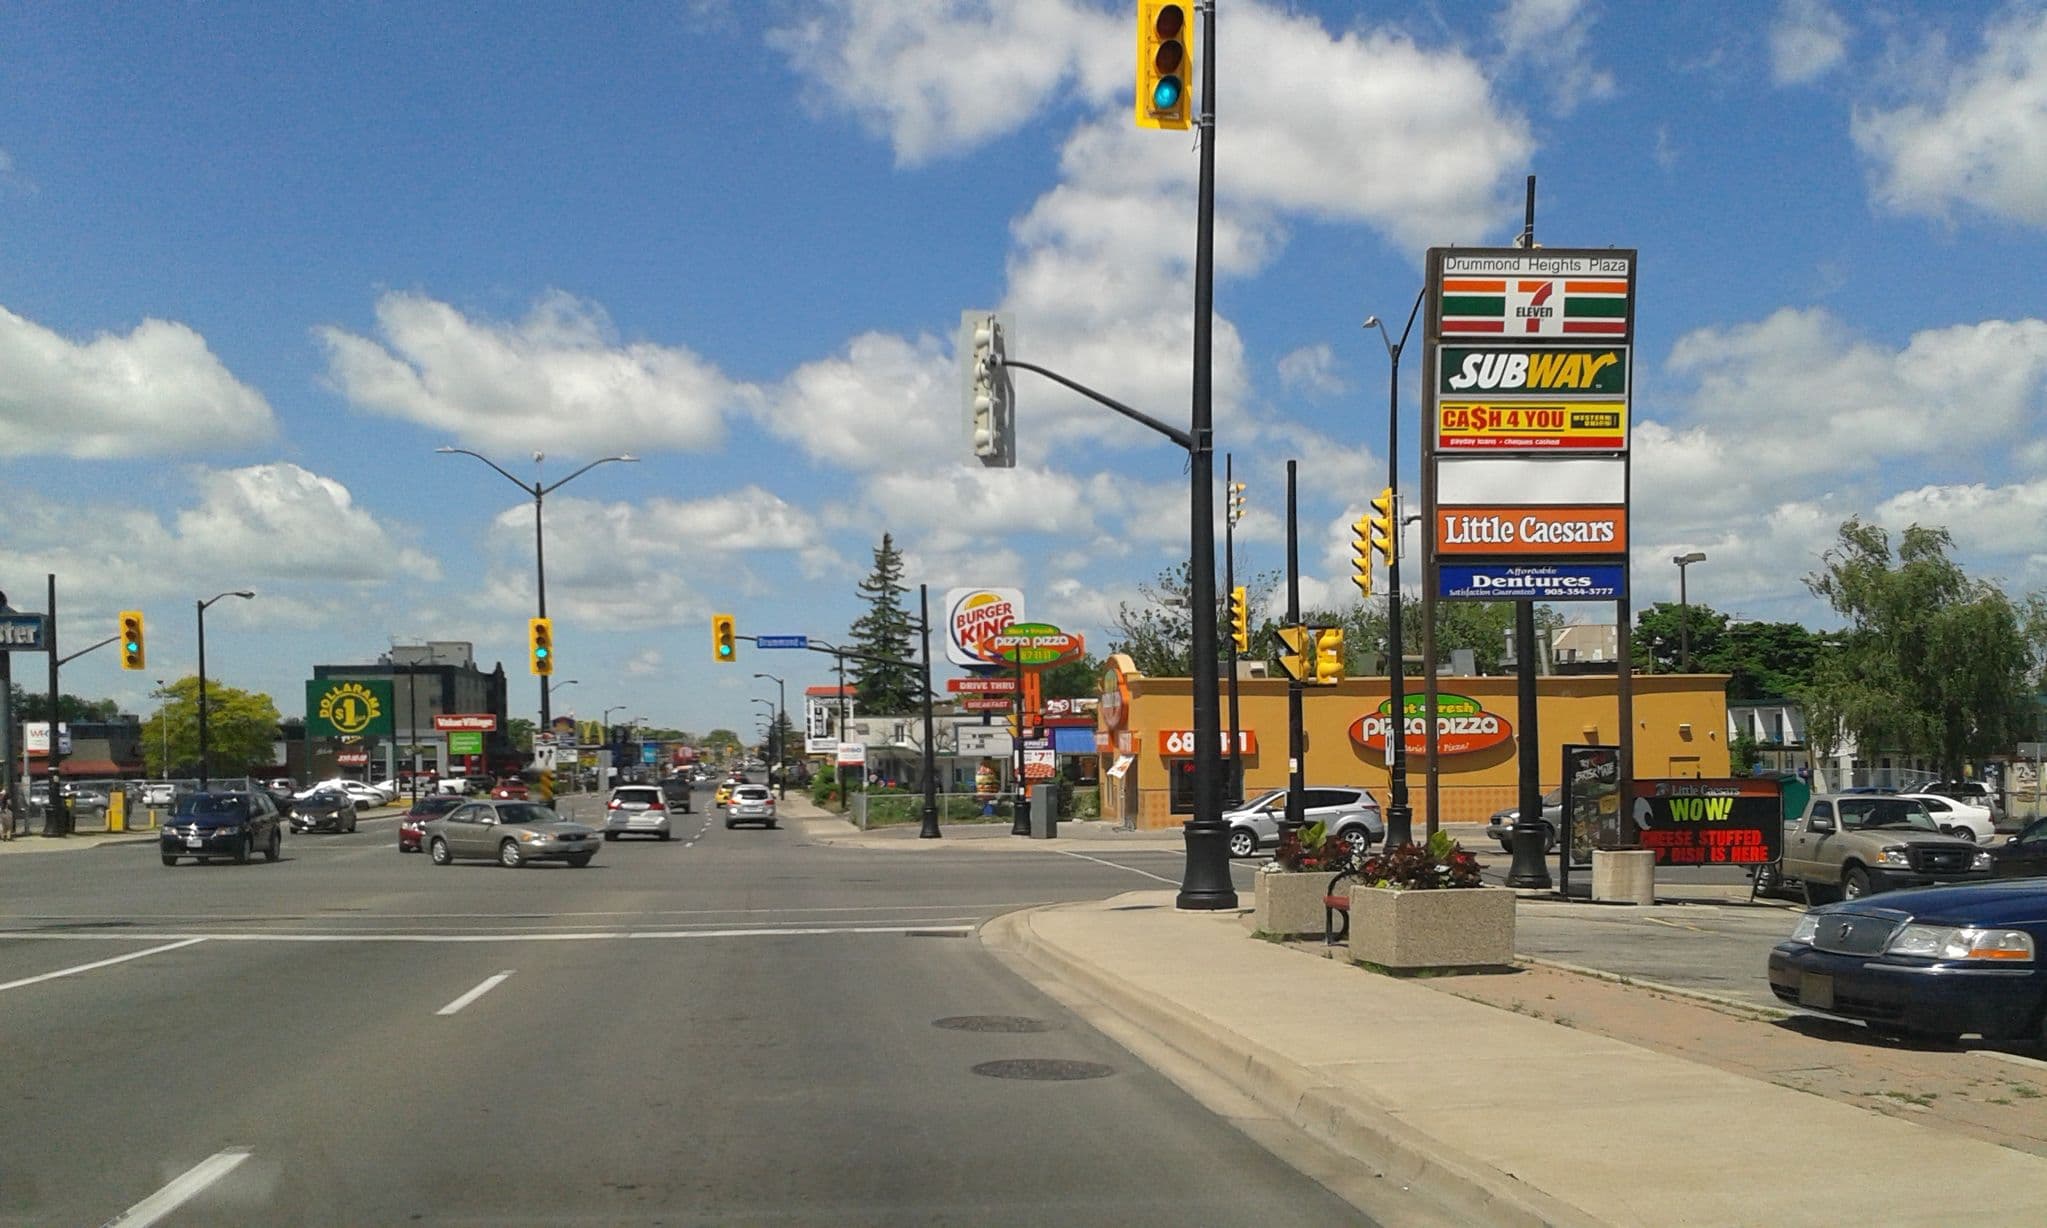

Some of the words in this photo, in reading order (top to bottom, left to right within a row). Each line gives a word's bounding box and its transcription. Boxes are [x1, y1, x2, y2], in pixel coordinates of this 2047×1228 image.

[1446, 257, 1520, 271] Drummond
[1528, 257, 1581, 273] Heights
[1589, 257, 1626, 272] Plaza
[1517, 280, 1553, 333] 7
[1449, 352, 1618, 390] SUBWAY
[1443, 406, 1502, 431] CA$H
[1507, 410, 1520, 428] 4
[1524, 410, 1565, 428] YOU
[1444, 516, 1514, 544] Little
[1519, 516, 1614, 544] Caesars
[1472, 574, 1592, 588] Dentures
[1506, 566, 1557, 577] Affordable
[957, 602, 1012, 628] BURGER
[995, 636, 1030, 649] pizza
[1033, 636, 1069, 649] pizza
[959, 682, 988, 690] DRIVE
[991, 682, 1015, 690] THRU
[319, 683, 381, 718] DOLLARAMA
[1436, 716, 1499, 741] pizza
[1671, 785, 1698, 796] Little
[1668, 797, 1734, 822] WOW!
[1699, 829, 1762, 846] STUFFED
[1711, 847, 1726, 862] IS
